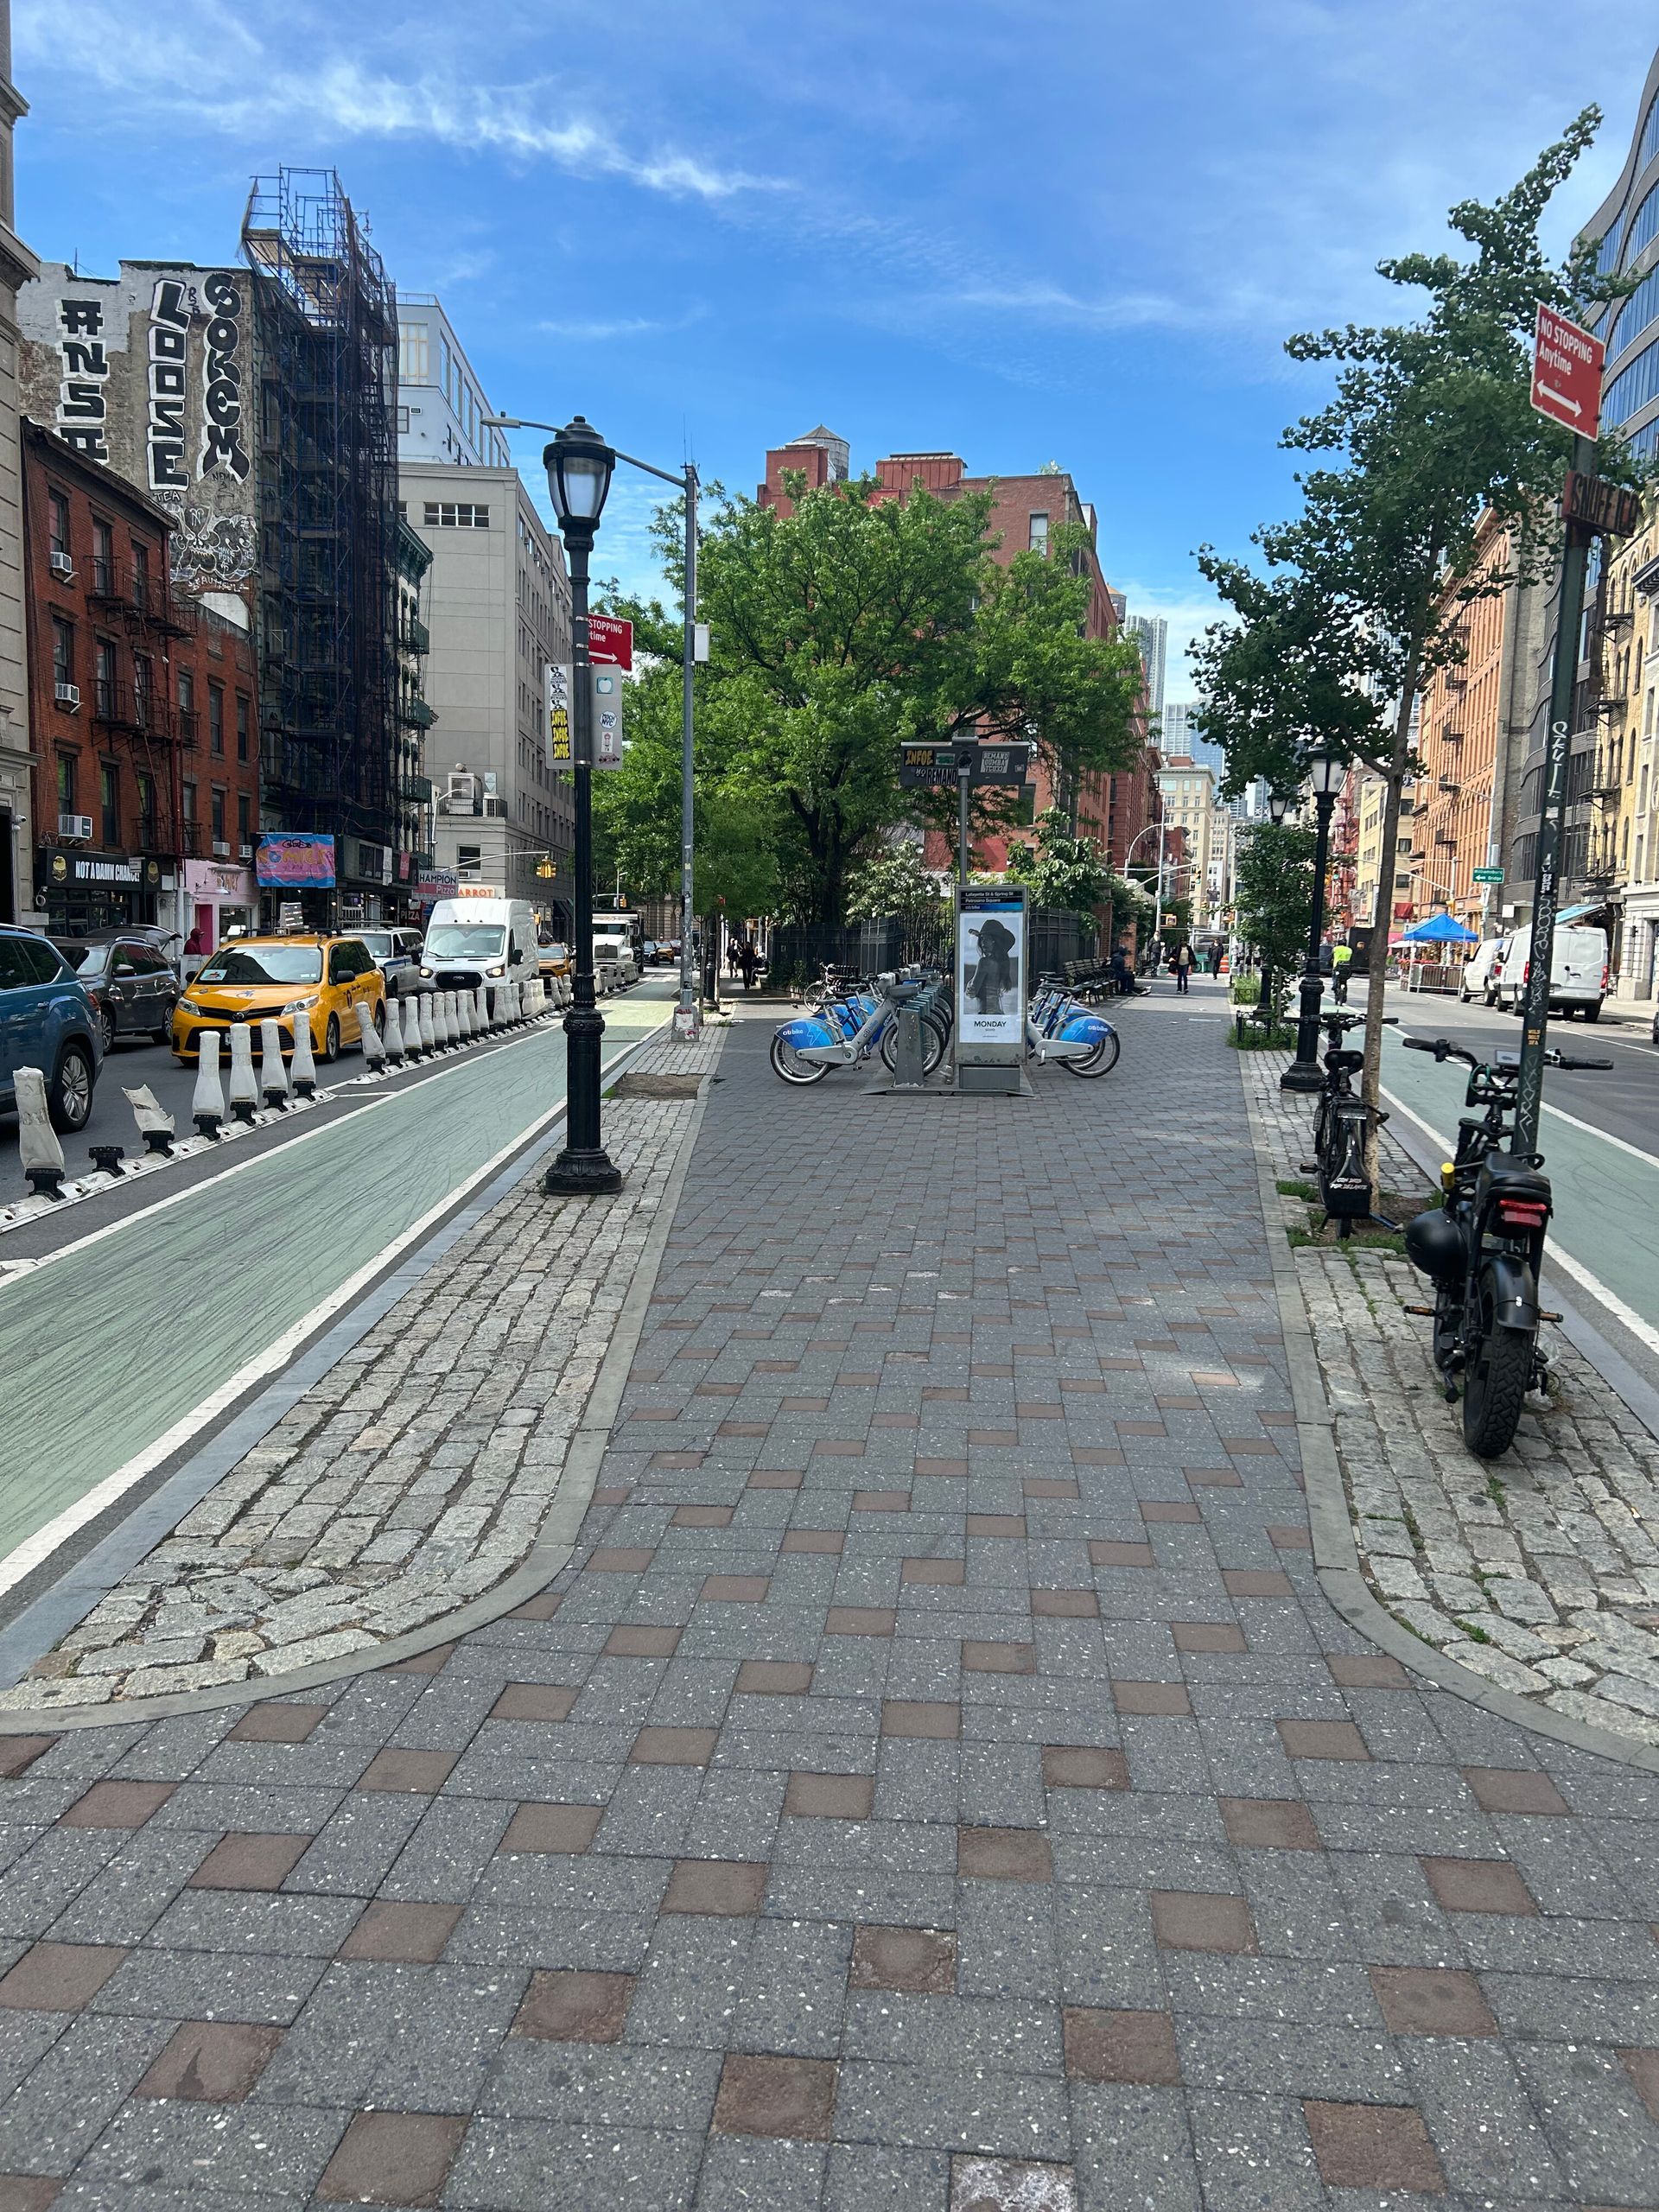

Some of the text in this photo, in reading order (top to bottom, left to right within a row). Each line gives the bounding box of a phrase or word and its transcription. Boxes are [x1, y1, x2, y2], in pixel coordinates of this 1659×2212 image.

[1541, 315, 1592, 364] NO STOPPING
[1539, 340, 1572, 375] Anytime
[147, 277, 192, 492] LOOSE
[154, 491, 181, 501] TEA
[588, 618, 623, 634] STOPPING
[588, 630, 607, 642] time
[927, 768, 957, 785] REMAND
[75, 861, 90, 879] NOT
[90, 862, 95, 880] A
[96, 863, 115, 881] DAMN
[435, 885, 455, 894] Pizza
[401, 910, 420, 920] PIZZA
